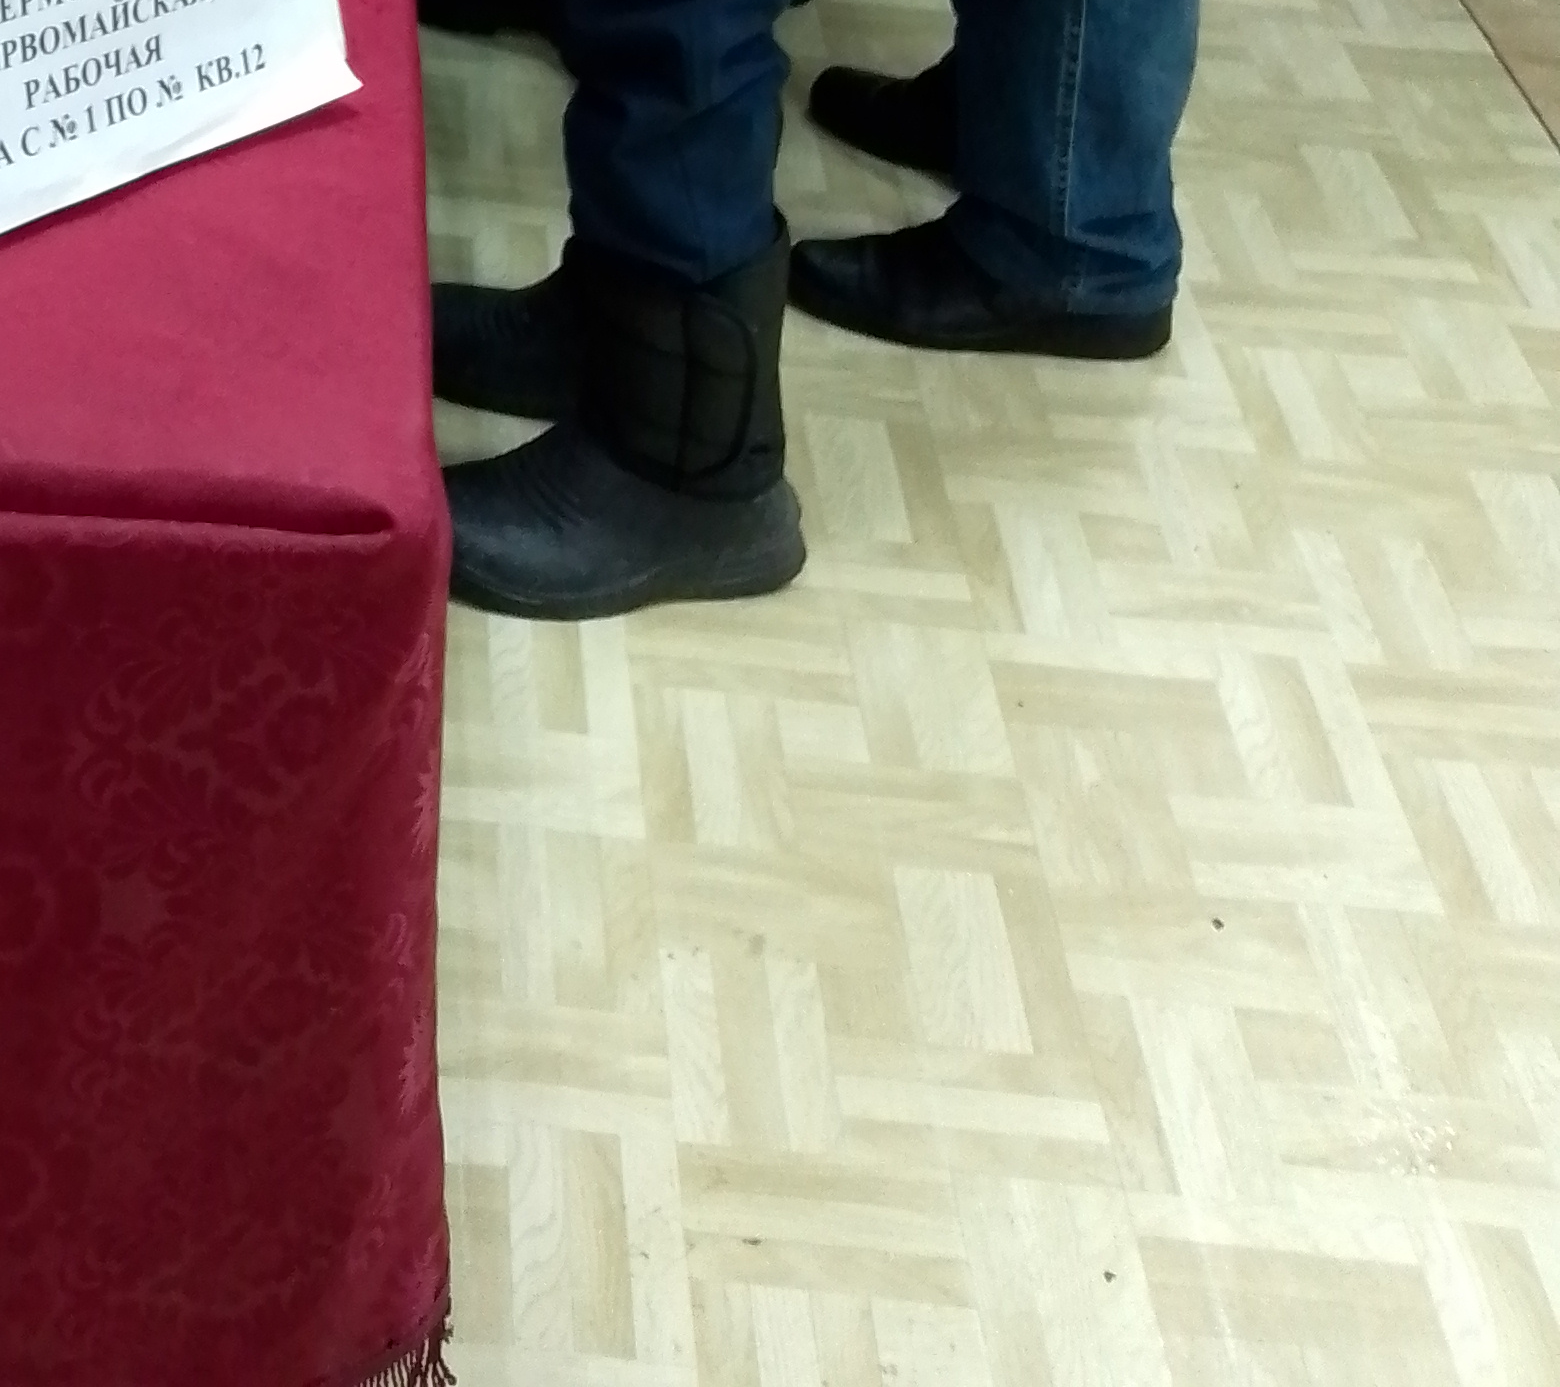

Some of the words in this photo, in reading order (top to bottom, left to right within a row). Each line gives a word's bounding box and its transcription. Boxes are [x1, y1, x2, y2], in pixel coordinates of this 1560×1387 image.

[20, 126, 41, 157] С
[105, 87, 148, 127] ПО
[195, 43, 266, 92] КВ.12
[24, 34, 164, 110] РАБОЧАЯ
